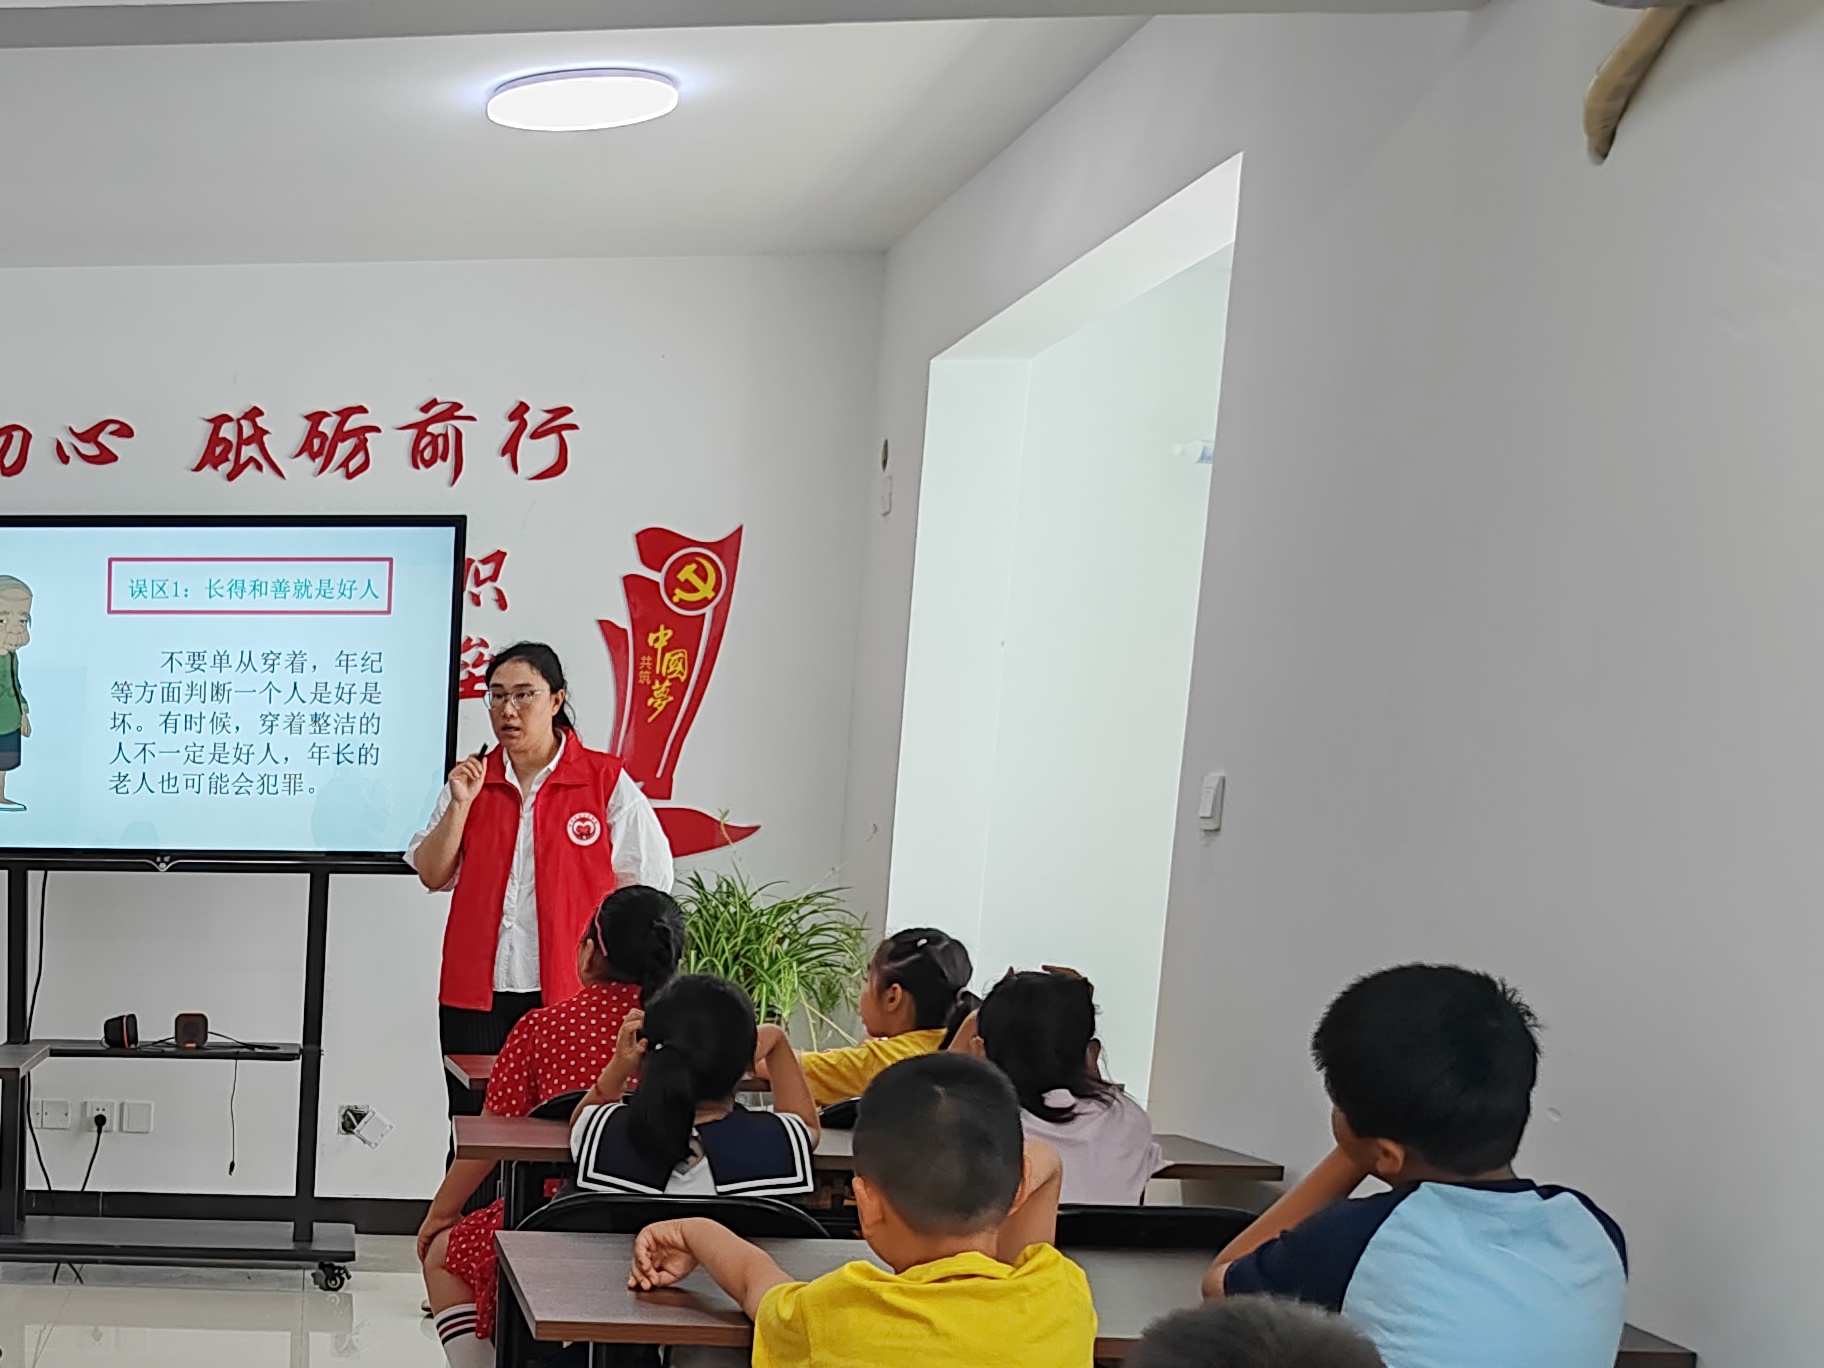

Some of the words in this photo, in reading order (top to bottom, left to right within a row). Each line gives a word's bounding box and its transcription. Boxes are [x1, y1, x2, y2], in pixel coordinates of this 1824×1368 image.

[190, 397, 580, 487] 砥砺前行
[128, 577, 380, 601] 误区1：长得和善就是好人
[160, 650, 383, 675] 不要单从穿着，年纪
[110, 680, 382, 706] 等方面判断一个人是好是
[109, 711, 381, 736] 坏。有时候，穿着整洁的
[109, 741, 380, 766] 人不一定是好人，年长的
[108, 771, 317, 796] 老人也可能会犯罪。
